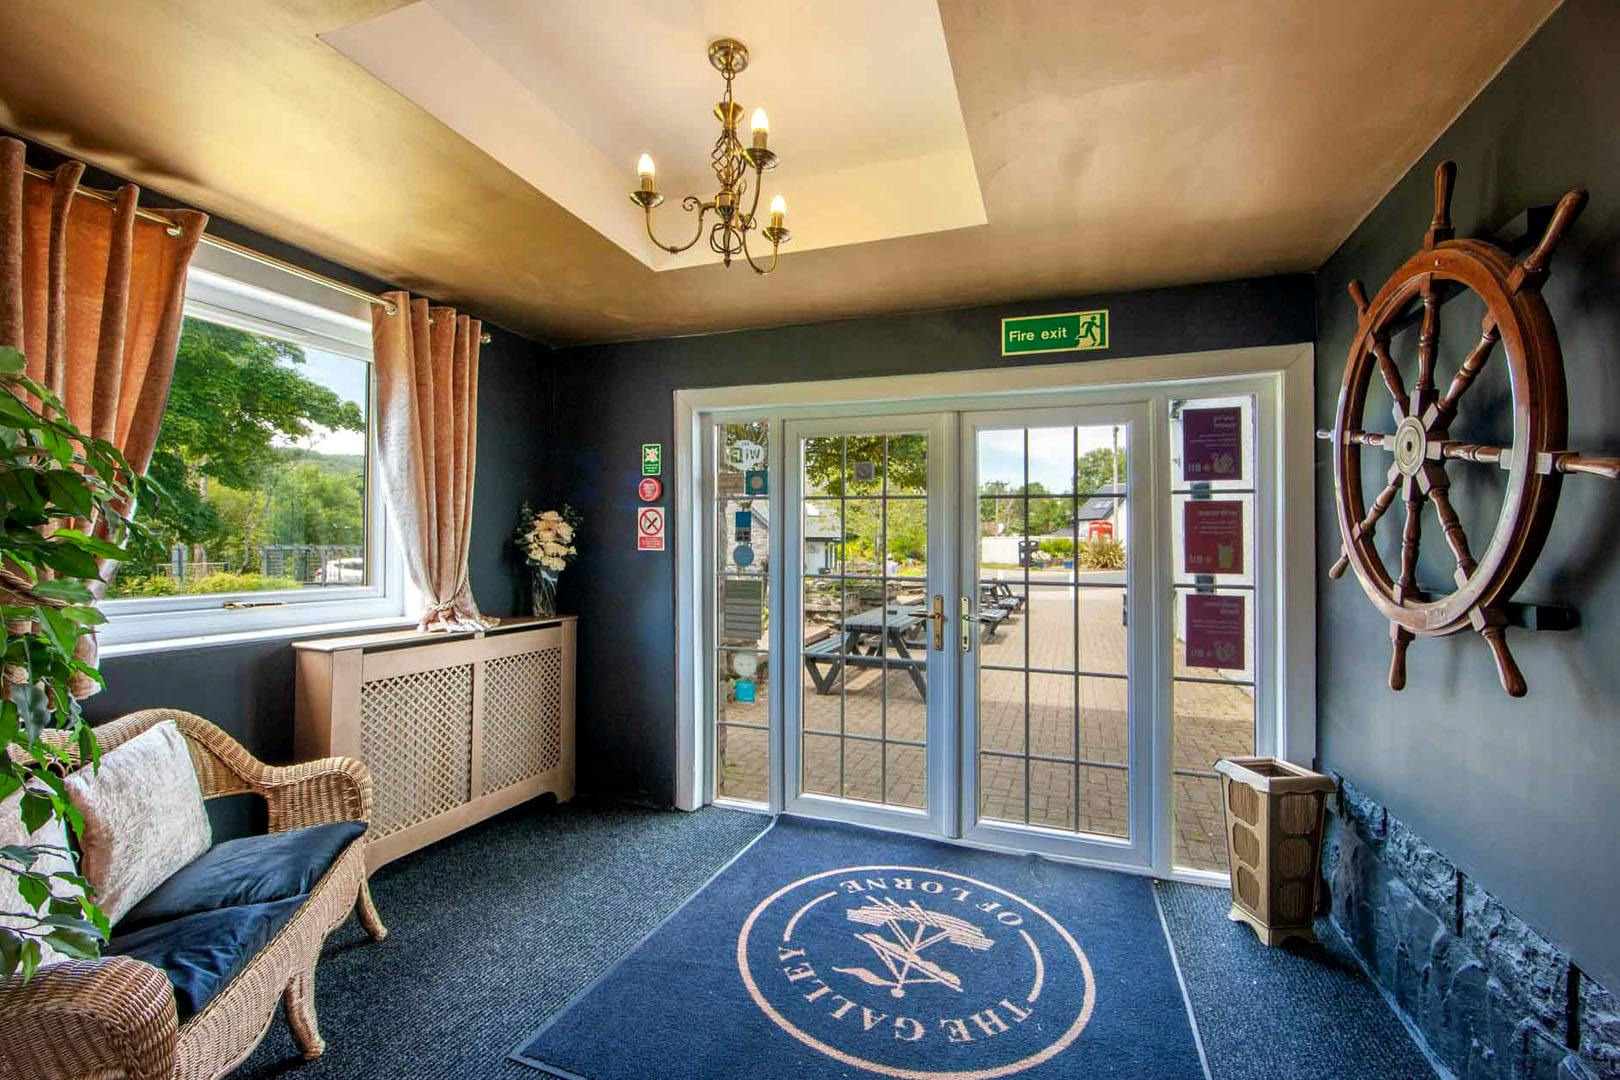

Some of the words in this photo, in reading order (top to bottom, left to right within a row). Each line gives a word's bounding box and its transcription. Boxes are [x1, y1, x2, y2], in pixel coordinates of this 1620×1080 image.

[1009, 330, 1035, 342] Fire
[1041, 327, 1067, 340] exit
[840, 877, 972, 902] LORNE
[975, 901, 1024, 927] OF
[777, 946, 925, 1041] GALLEY
[940, 998, 1033, 1043] THE
